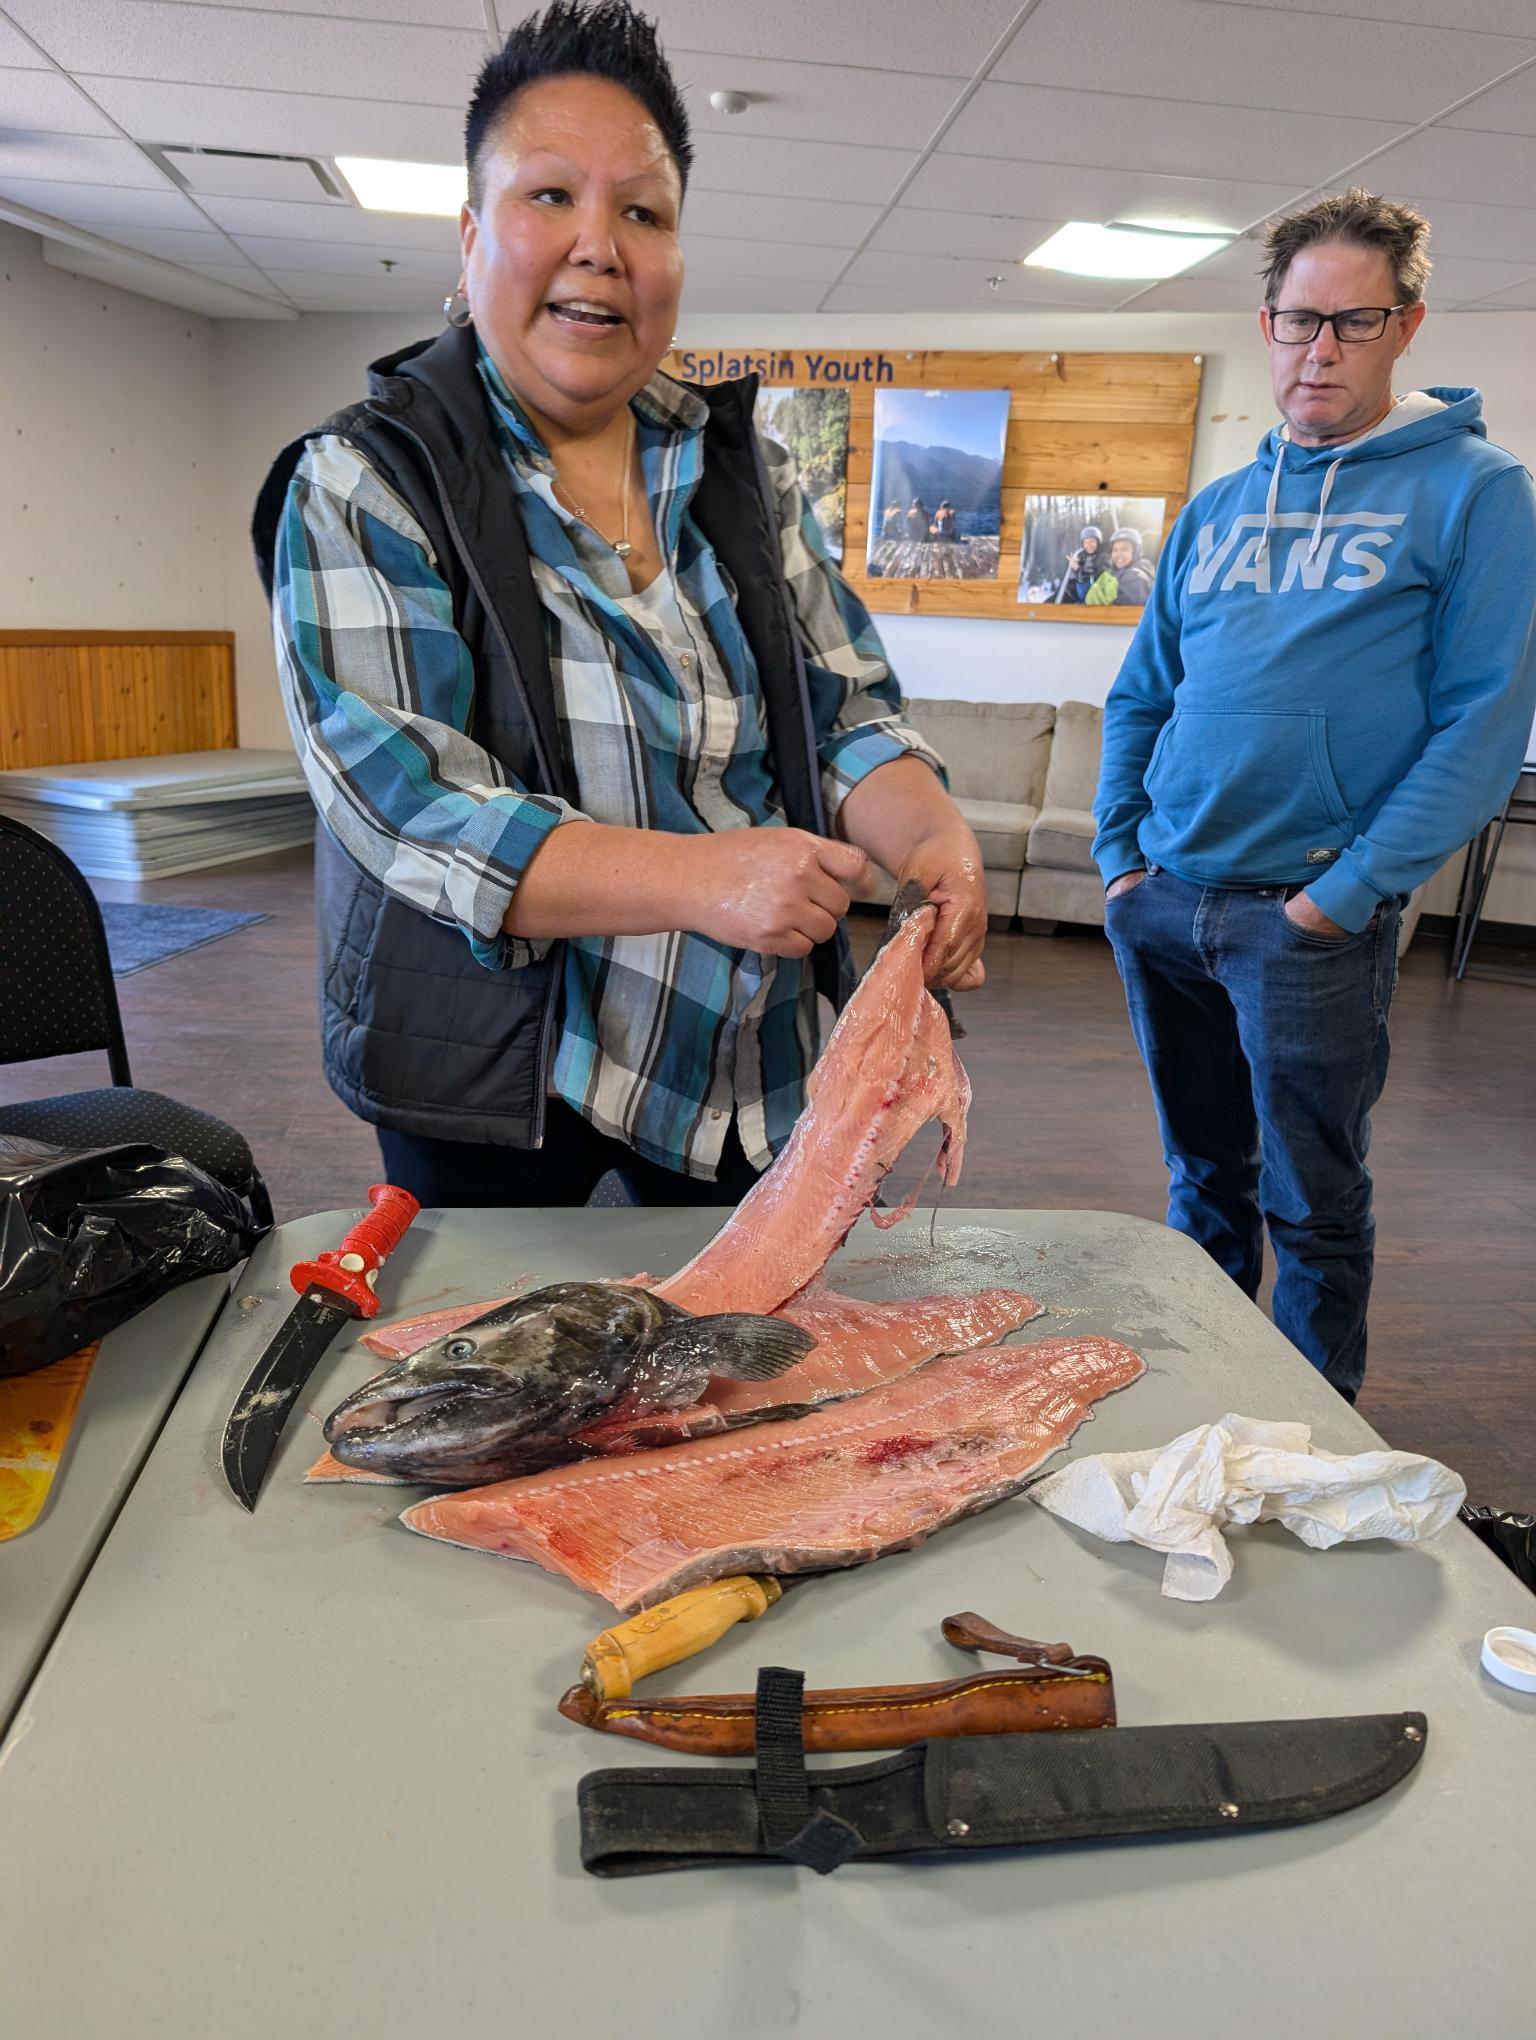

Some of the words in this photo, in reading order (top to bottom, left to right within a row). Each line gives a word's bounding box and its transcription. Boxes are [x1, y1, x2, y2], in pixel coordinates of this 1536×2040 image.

[682, 351, 795, 385] Splatsin
[805, 354, 893, 382] Youth
[1188, 511, 1407, 594] VANS
